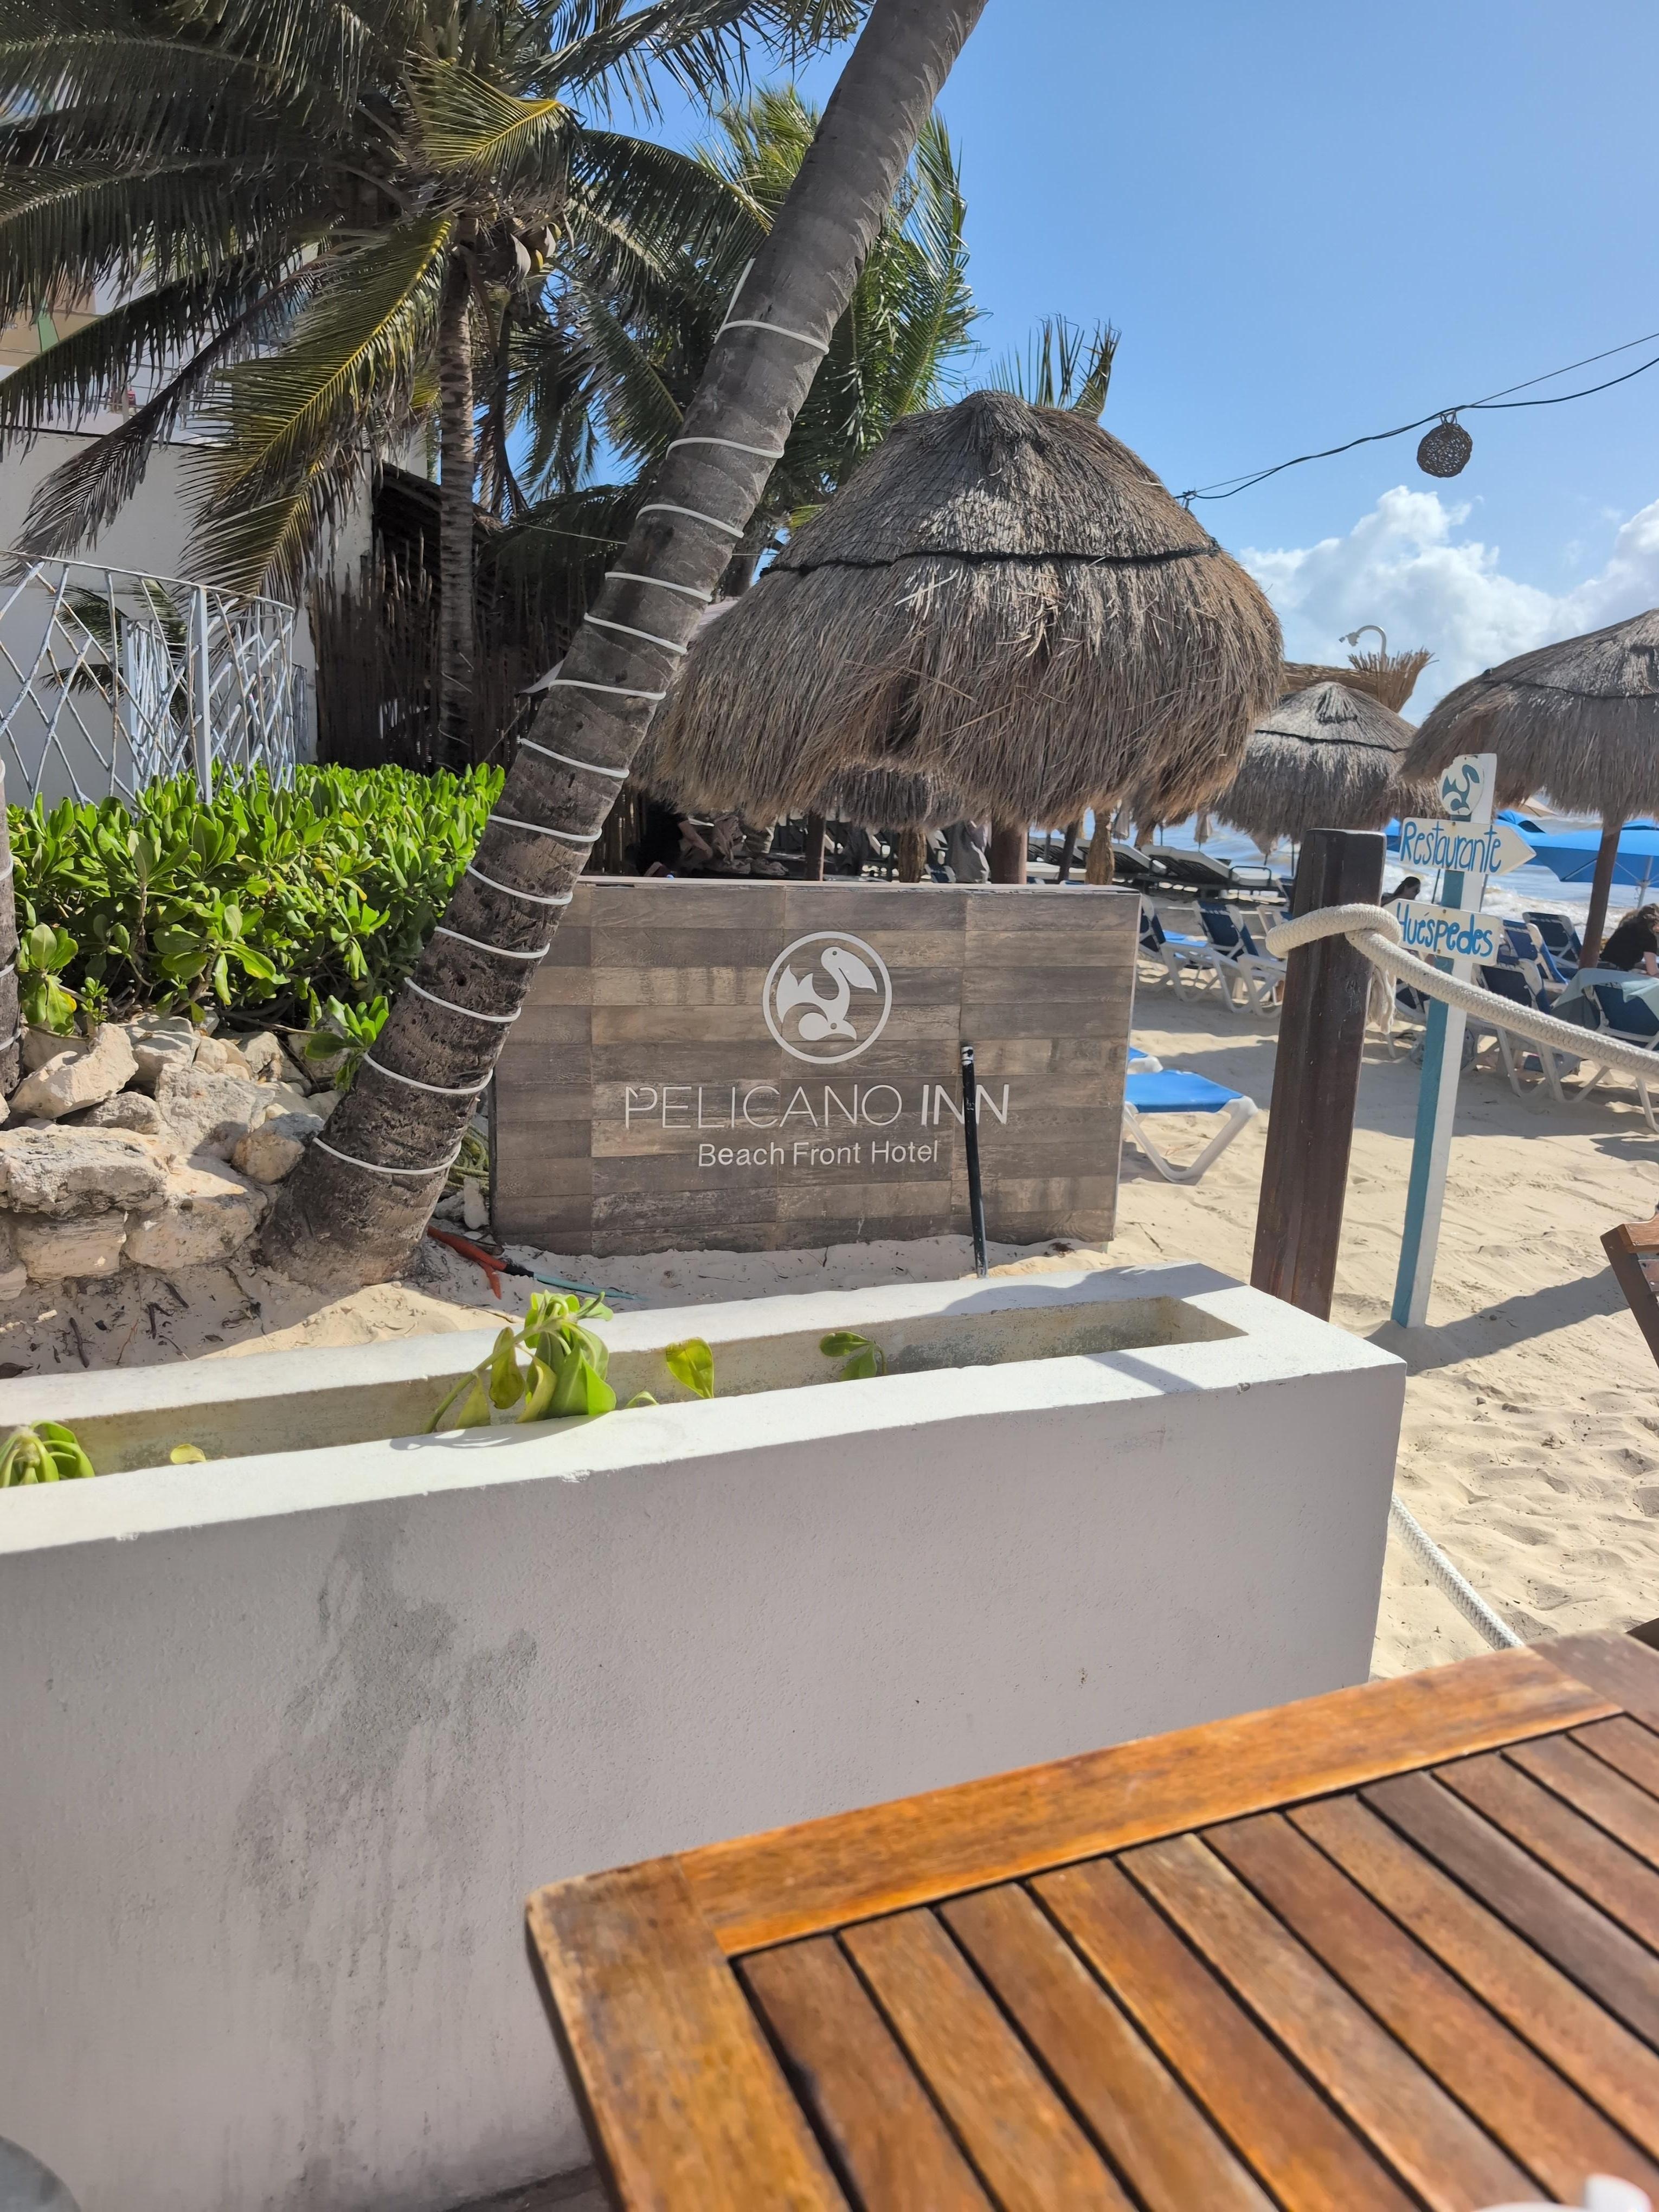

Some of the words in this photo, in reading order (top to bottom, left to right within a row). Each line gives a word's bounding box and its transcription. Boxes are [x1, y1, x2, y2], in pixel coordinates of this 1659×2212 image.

[1401, 821, 1501, 873] Restaurante
[625, 1084, 902, 1129] PELICANO
[921, 1084, 1009, 1126] INN
[698, 1142, 785, 1167] Beach
[793, 1142, 861, 1166] Front
[872, 1140, 938, 1163] Hotel
